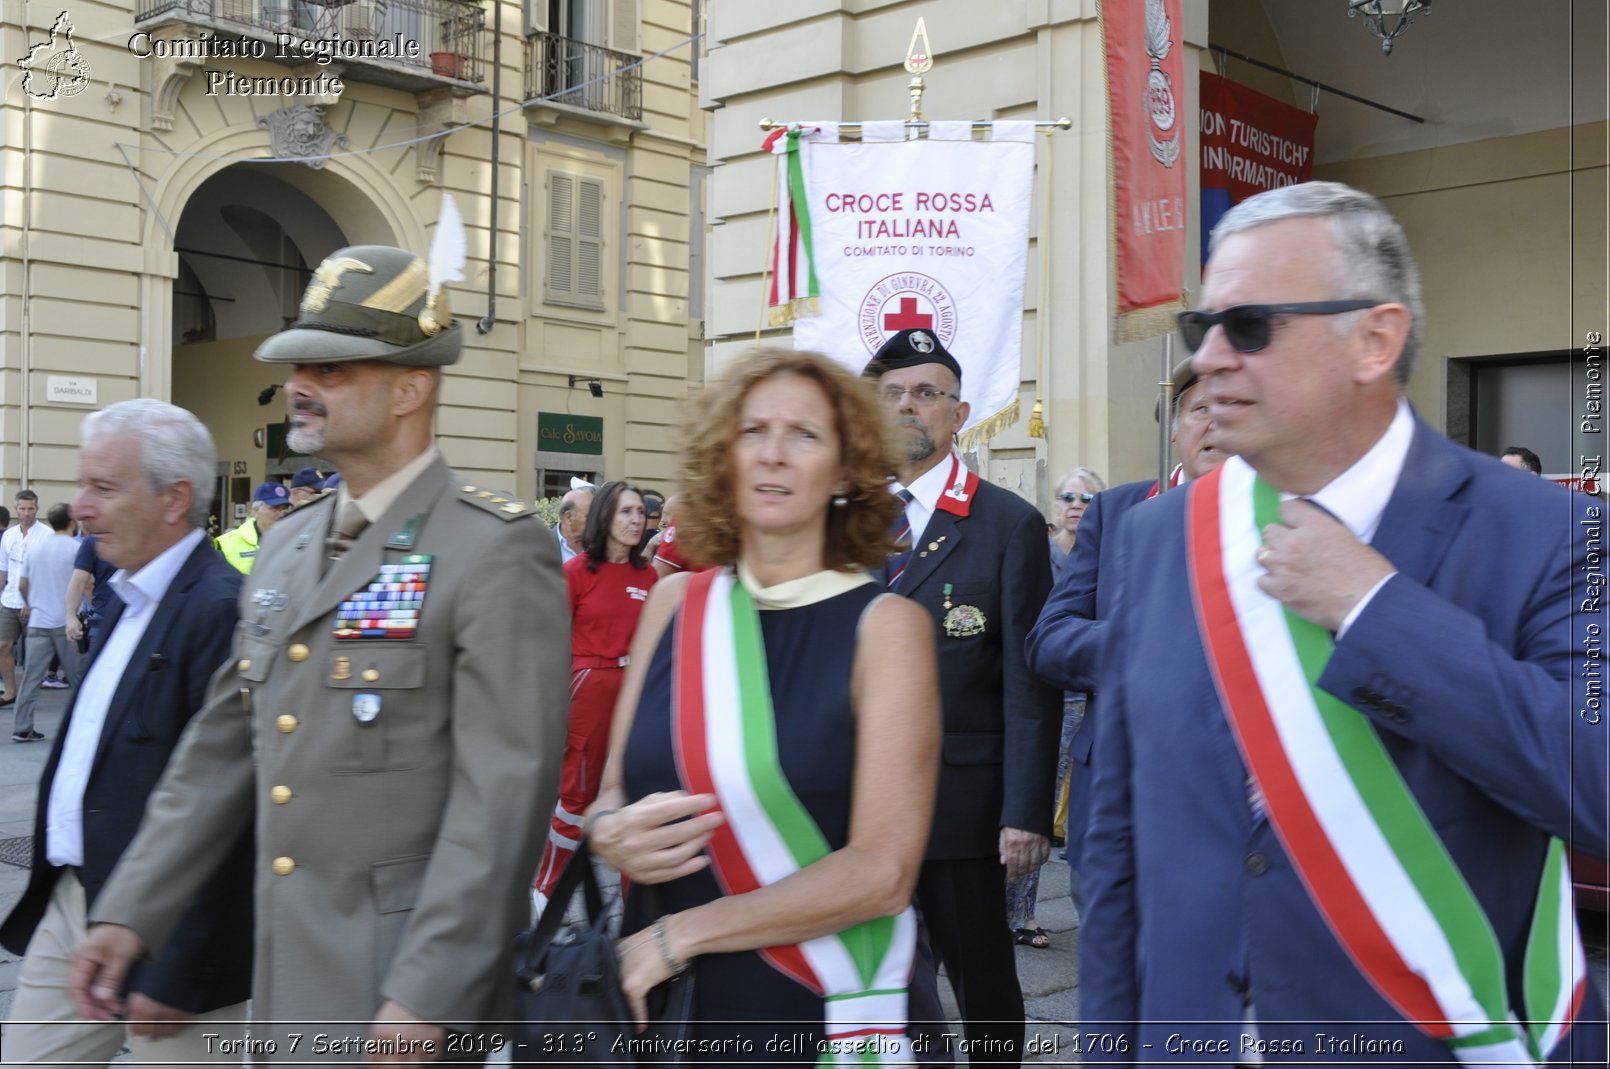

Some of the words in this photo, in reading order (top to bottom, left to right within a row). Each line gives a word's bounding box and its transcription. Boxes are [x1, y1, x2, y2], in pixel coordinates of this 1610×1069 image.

[825, 192, 904, 213] CROCE
[916, 192, 994, 213] ROSSA
[858, 219, 960, 239] ITALIANA
[844, 246, 908, 257] COMITATO
[912, 246, 924, 256] DI
[929, 246, 975, 257] TORINO
[891, 276, 935, 295] GINEVRA
[938, 305, 953, 341] AGOSTO
[233, 460, 247, 475] 153
